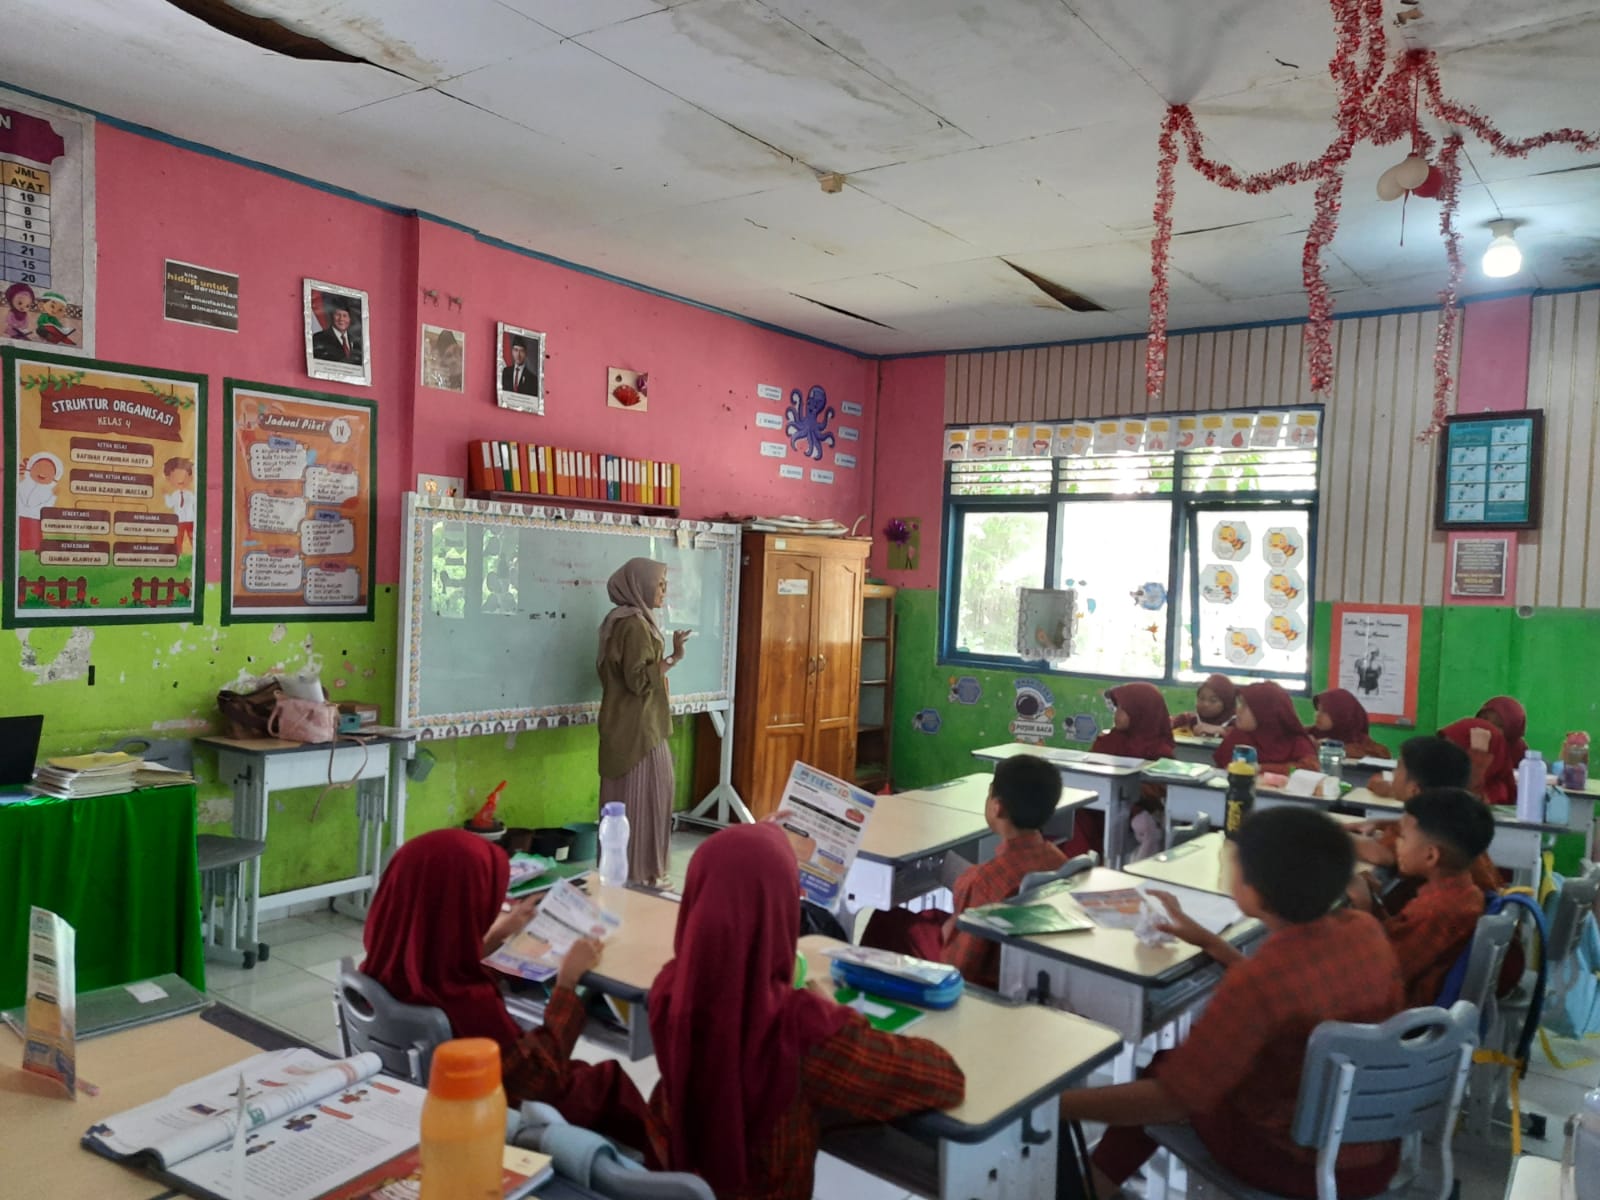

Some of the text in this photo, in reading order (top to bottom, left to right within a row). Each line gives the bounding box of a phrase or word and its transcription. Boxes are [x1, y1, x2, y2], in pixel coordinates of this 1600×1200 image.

[15, 166, 40, 180] JML
[11, 178, 45, 193] AYAT
[20, 192, 35, 203] 19
[24, 206, 32, 216] 8
[24, 220, 32, 229] 8
[23, 234, 34, 243] 11
[21, 247, 34, 256] 21
[22, 260, 35, 270] 15
[22, 273, 35, 284] 20
[167, 272, 198, 286] hidup
[200, 280, 229, 292] untuk
[52, 398, 175, 426] STRUKTUR ORGANISASI
[97, 416, 132, 429] KELAS 4
[264, 414, 326, 431] Jadwal Piket
[336, 425, 345, 437] IV
